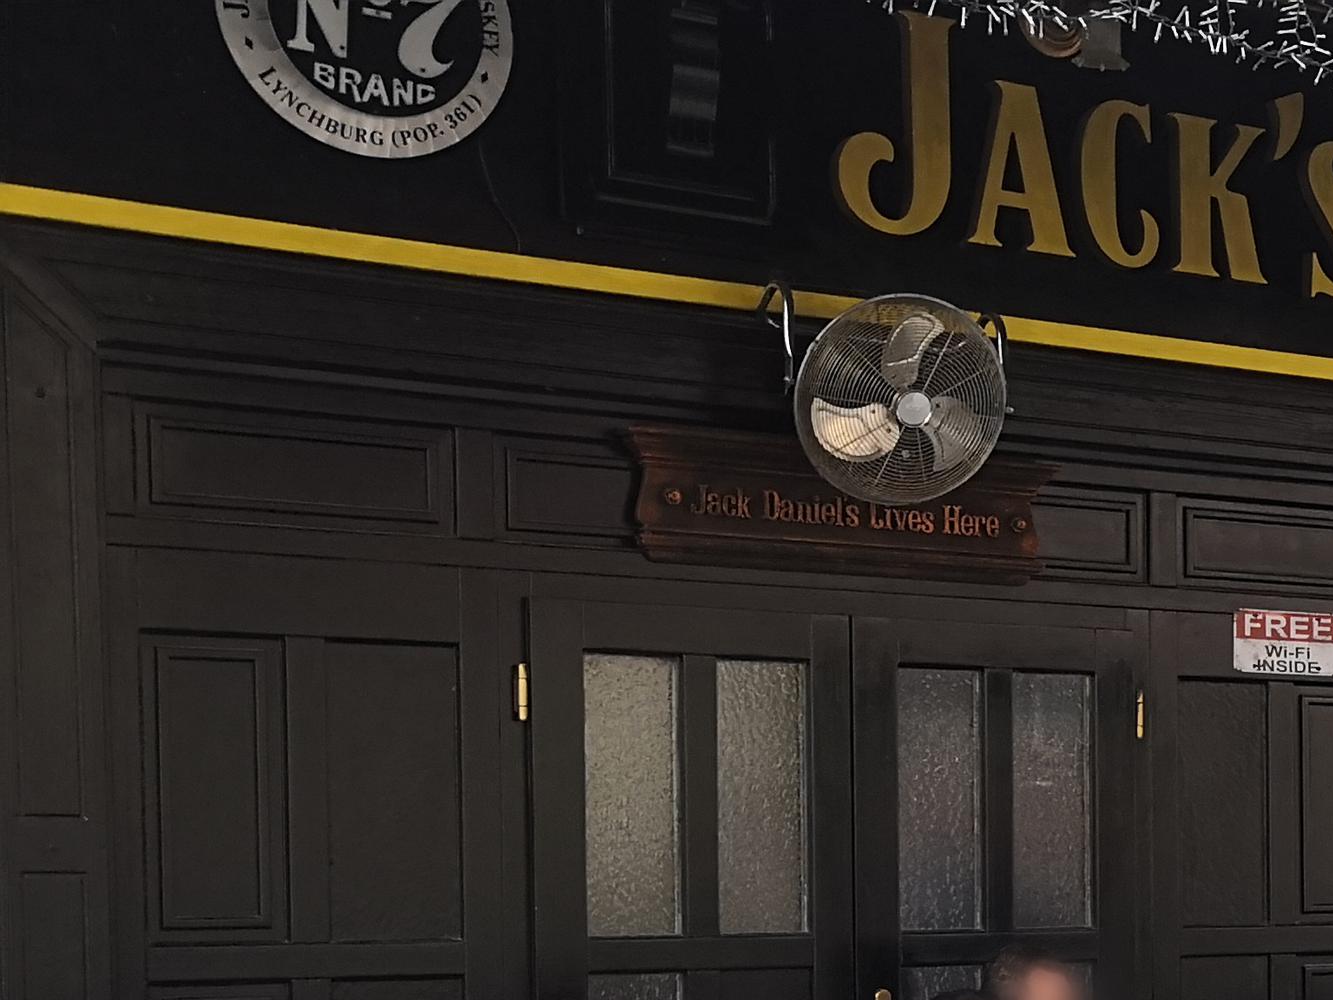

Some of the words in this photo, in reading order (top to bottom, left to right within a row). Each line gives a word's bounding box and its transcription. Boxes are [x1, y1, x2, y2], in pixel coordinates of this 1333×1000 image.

[313, 62, 436, 106] BRAND
[258, 66, 384, 146] LYNCHBURG
[444, 94, 483, 128] 361)
[691, 484, 752, 520] Jack
[942, 506, 1000, 537] Here
[1244, 613, 1333, 641] FREE
[1257, 659, 1322, 674] INSIDE
[1265, 645, 1311, 660] Wi-Fi
